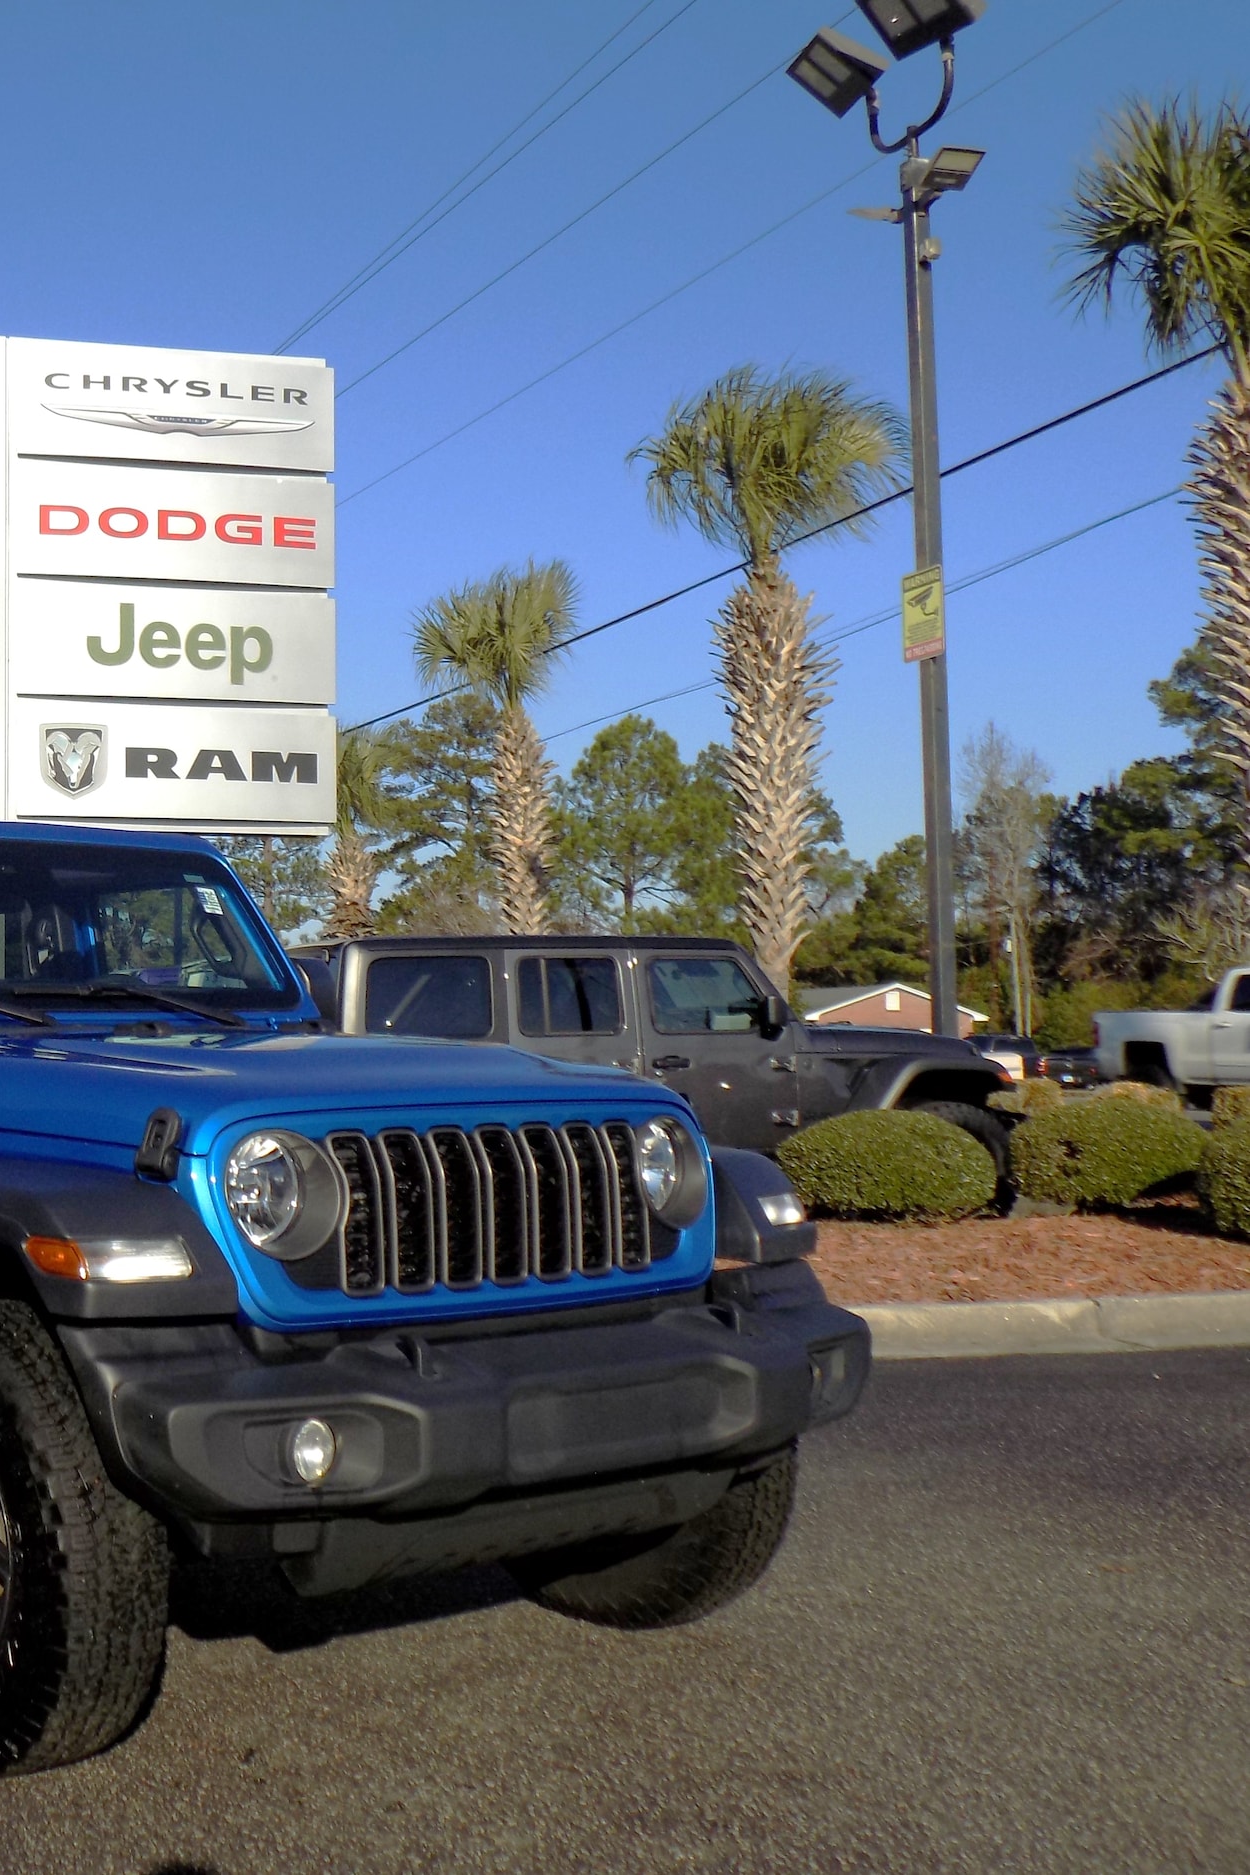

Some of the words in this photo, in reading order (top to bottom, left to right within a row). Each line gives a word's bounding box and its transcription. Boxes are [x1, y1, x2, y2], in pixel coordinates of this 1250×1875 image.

[44, 373, 308, 406] CHRYSLER
[39, 504, 317, 550] DODGE
[86, 603, 273, 686] Jeep
[125, 747, 318, 784] RAM
